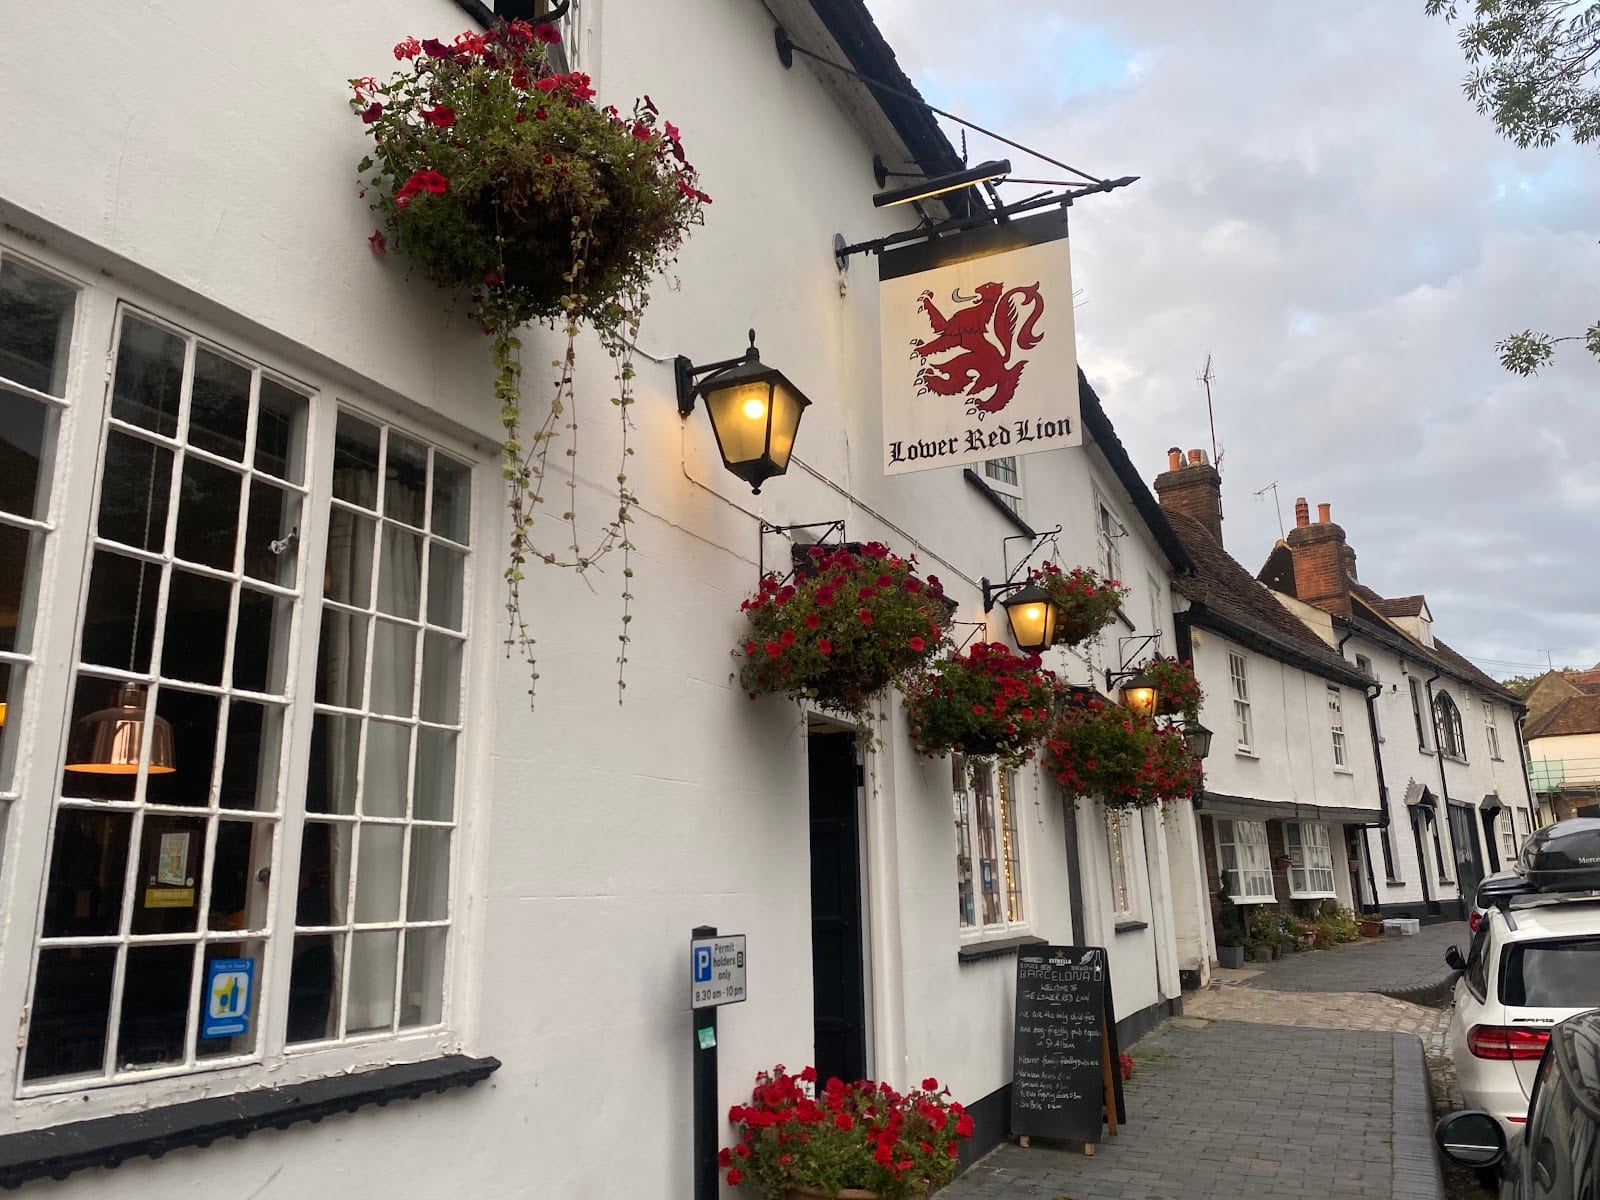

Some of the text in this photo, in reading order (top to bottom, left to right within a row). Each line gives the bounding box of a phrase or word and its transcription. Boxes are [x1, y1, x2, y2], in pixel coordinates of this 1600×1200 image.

[888, 417, 1072, 466] Lower Red Lion
[714, 943, 735, 954] Permit
[698, 950, 710, 979] P
[713, 956, 736, 968] holders
[718, 969, 731, 981] only
[1019, 969, 1091, 981] BARCELONA
[695, 989, 712, 1002] 8.30
[712, 990, 722, 999] am
[726, 987, 733, 997] 10
[733, 986, 744, 997] pm
[1023, 990, 1036, 1000] THE
[1036, 992, 1060, 1002] LOWER
[1061, 994, 1073, 1002] RED
[1056, 1010, 1069, 1024] only
